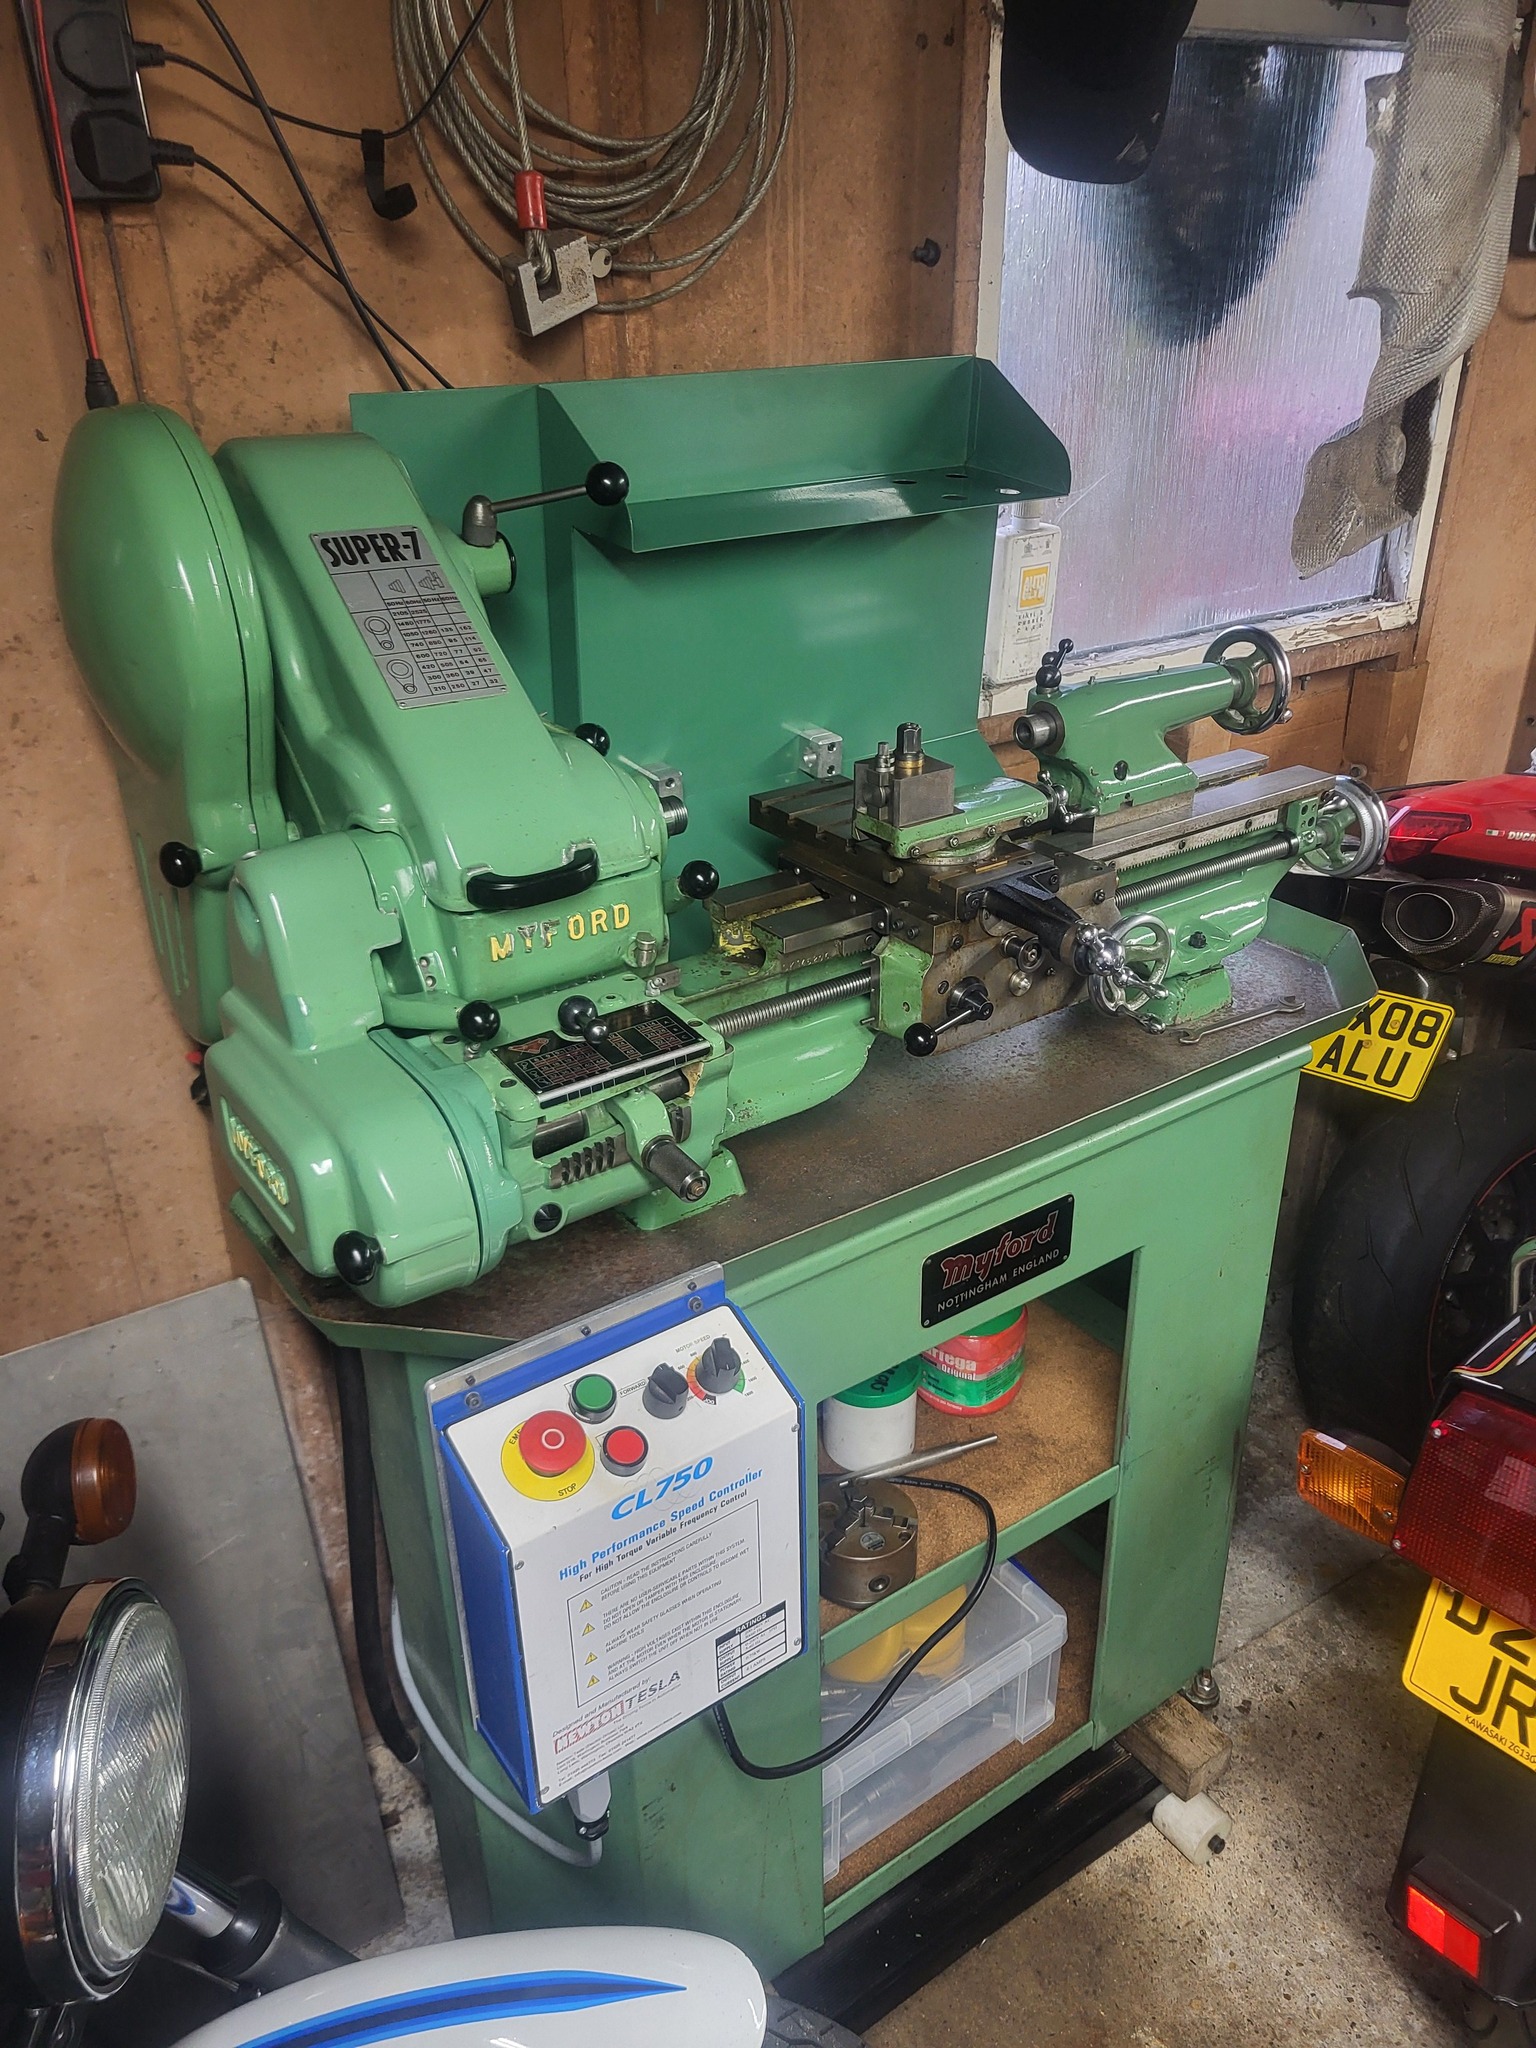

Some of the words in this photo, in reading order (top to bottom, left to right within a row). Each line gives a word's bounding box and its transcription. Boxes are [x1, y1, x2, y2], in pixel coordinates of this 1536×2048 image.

[320, 531, 421, 567] SUPER-7
[490, 903, 630, 962] MYFORD
[1316, 1034, 1412, 1088] ALU
[940, 1210, 1059, 1290] Myford
[937, 1272, 1007, 1312] NOTTINGHAM
[1012, 1248, 1060, 1276] ENGLAND
[694, 1334, 711, 1347] SPEED
[620, 1380, 646, 1396] FORWARD
[942, 1364, 976, 1381] Original
[558, 1482, 576, 1497] STOP
[611, 1456, 713, 1520] CL750
[559, 1557, 587, 1581] High
[591, 1519, 665, 1562] Performance
[670, 1496, 704, 1525] Speed
[709, 1465, 762, 1503] Controller
[579, 1568, 592, 1582] For
[594, 1557, 613, 1573] High
[616, 1542, 642, 1562] Torque
[645, 1525, 676, 1546] Variable
[680, 1504, 717, 1529] Frequency
[720, 1488, 747, 1508] Control
[600, 1580, 622, 1594] CAUTION
[735, 1612, 766, 1633] RATINGS
[552, 1716, 582, 1737] Designed
[584, 1706, 598, 1719] and
[598, 1682, 640, 1709] Manufactured
[555, 1701, 622, 1753] NEWTON
[625, 1670, 680, 1708] TESLA
[1464, 1714, 1508, 1746] KAWASAKI
